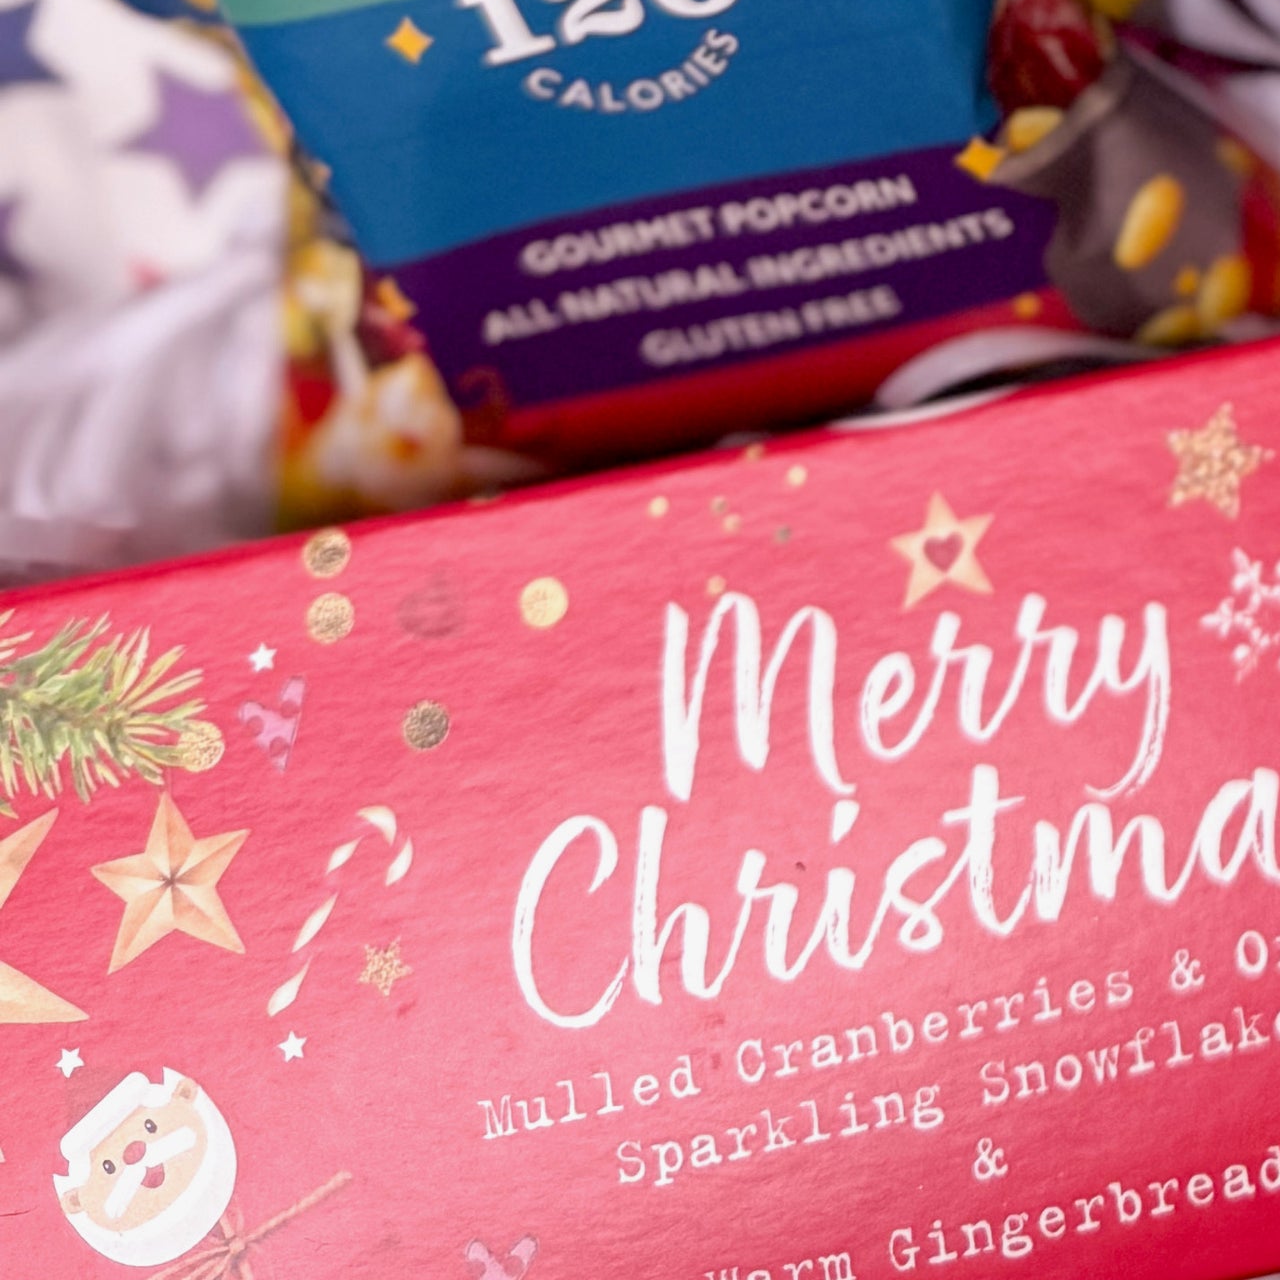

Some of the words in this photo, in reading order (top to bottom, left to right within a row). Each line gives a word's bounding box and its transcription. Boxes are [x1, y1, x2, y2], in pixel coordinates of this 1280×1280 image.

[520, 27, 740, 114] CALORIES
[482, 289, 553, 344] ALL
[558, 262, 748, 322] NATURAL
[746, 206, 1015, 289] INGREDIENTS
[519, 206, 715, 275] GOURMET
[720, 173, 919, 237] POPCORN
[640, 301, 798, 366] GLUTEN
[801, 286, 902, 330] FREE
[658, 592, 1172, 802] Merry
[477, 1053, 697, 1141] Mulled
[735, 971, 1135, 1085] Cranberries
[1168, 949, 1203, 992] &
[615, 1082, 945, 1188] Sparkling
[973, 1137, 1009, 1180] &
